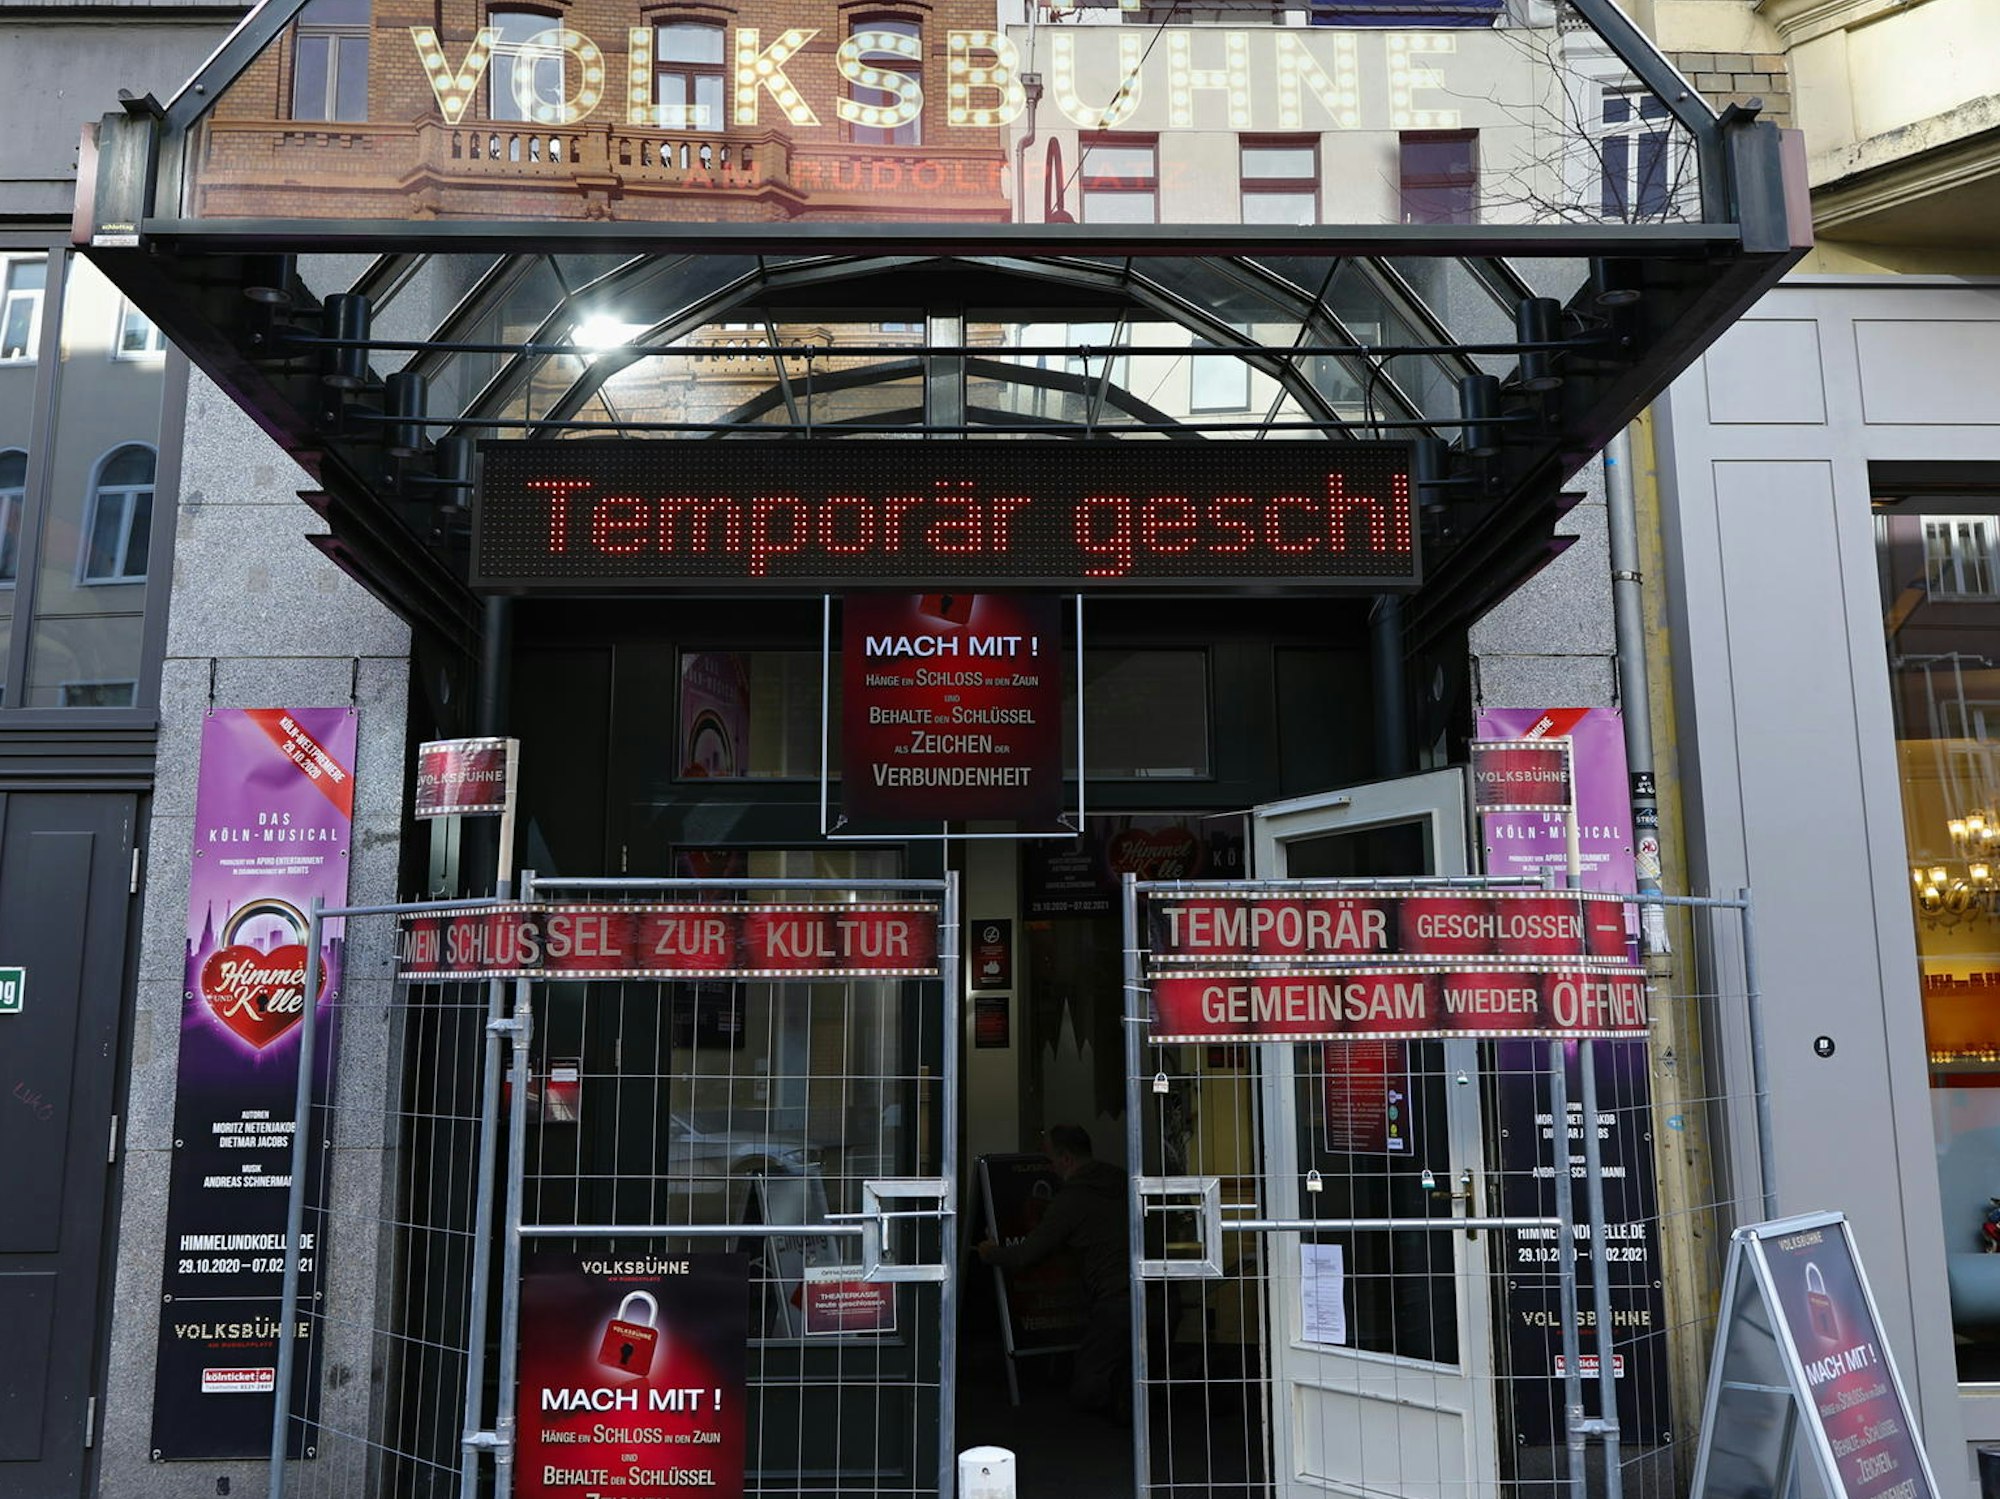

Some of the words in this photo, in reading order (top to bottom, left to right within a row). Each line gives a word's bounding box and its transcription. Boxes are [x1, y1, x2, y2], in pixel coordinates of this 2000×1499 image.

[680, 160, 761, 190] AM
[793, 160, 1192, 190] RUDOLFPATZ
[528, 479, 1032, 577] Temporär
[1075, 473, 1411, 577] geschl
[866, 636, 958, 657] MACH
[968, 636, 1022, 657] MIT
[1031, 636, 1039, 657] !
[866, 673, 900, 687] HÄNGE
[901, 678, 914, 686] EIN
[916, 668, 983, 687] SCHLOSS
[985, 678, 994, 686] IN
[995, 678, 1010, 686] DEN
[1012, 674, 1039, 687] ZAUN
[944, 694, 961, 703] UND
[869, 707, 932, 724] BEHALTE
[934, 716, 950, 724] DEN
[952, 706, 1035, 725] SCHLÜSSEL
[279, 716, 346, 783] KÖLN-WELTPREMIERE
[894, 746, 909, 754] ALS
[910, 731, 992, 754] ZEICHEN
[994, 746, 1010, 754] DER
[282, 740, 321, 779] 29.10.2020
[420, 767, 503, 785] VOLKSBÜHNE
[873, 764, 1032, 787] VERBUNDENHEIT
[1477, 766, 1568, 782] VOLKSBÜHNE
[259, 812, 291, 825] DAS
[1543, 813, 1562, 823] DA
[209, 827, 338, 842] KÖLN-MUSICAL
[1163, 902, 1387, 948] TEMPORÄR
[1417, 914, 1582, 939] GESCHLOSSEN
[403, 929, 440, 964] MEIN
[446, 915, 622, 965] SCHLÜSSEL
[655, 919, 727, 955] ZUR
[766, 919, 910, 957] KULTUR
[214, 959, 306, 992] Himme
[1202, 984, 1426, 1024] GEMEINSAM
[1444, 989, 1538, 1014] WIEDER
[1553, 972, 1647, 1027] ÖFFNEN
[241, 1110, 270, 1119] AUTOREN
[212, 1122, 243, 1133] MORITZ
[219, 1136, 256, 1148] DIETMAR
[257, 1136, 289, 1148] JACOBS
[242, 1164, 262, 1173] MUSIK
[203, 1176, 243, 1188] ANDREAS
[243, 1175, 292, 1187] SCHNERMA
[180, 1234, 315, 1251] HIMMELUNDKOELLDE
[178, 1258, 313, 1274] 29.10.2020–07.02.21
[581, 1257, 690, 1275] VOLKSBÜHNE
[816, 1301, 837, 1309] heute
[838, 1299, 886, 1309] geschlossen
[820, 1290, 880, 1300] THEATERKASSE
[1522, 1305, 1651, 1326] VOLSBHNE
[175, 1316, 310, 1340] VOLKSBÜHE
[1805, 1353, 1846, 1386] MACH
[1844, 1345, 1869, 1372] MIT
[1868, 1343, 1877, 1363] !
[541, 1388, 638, 1411] MACH
[648, 1388, 705, 1411] MIT
[713, 1388, 721, 1411] !
[541, 1429, 576, 1443] HÄNGE
[578, 1435, 591, 1443] EIN
[593, 1424, 662, 1443] SCHLOSS
[664, 1435, 673, 1443] IN
[674, 1435, 691, 1443] DEN
[692, 1430, 721, 1443] ZAUN
[621, 1453, 638, 1462] UND
[543, 1465, 608, 1485] BEHALTE
[610, 1477, 626, 1485] DEN
[628, 1466, 716, 1485] SCHLÜSSEL
